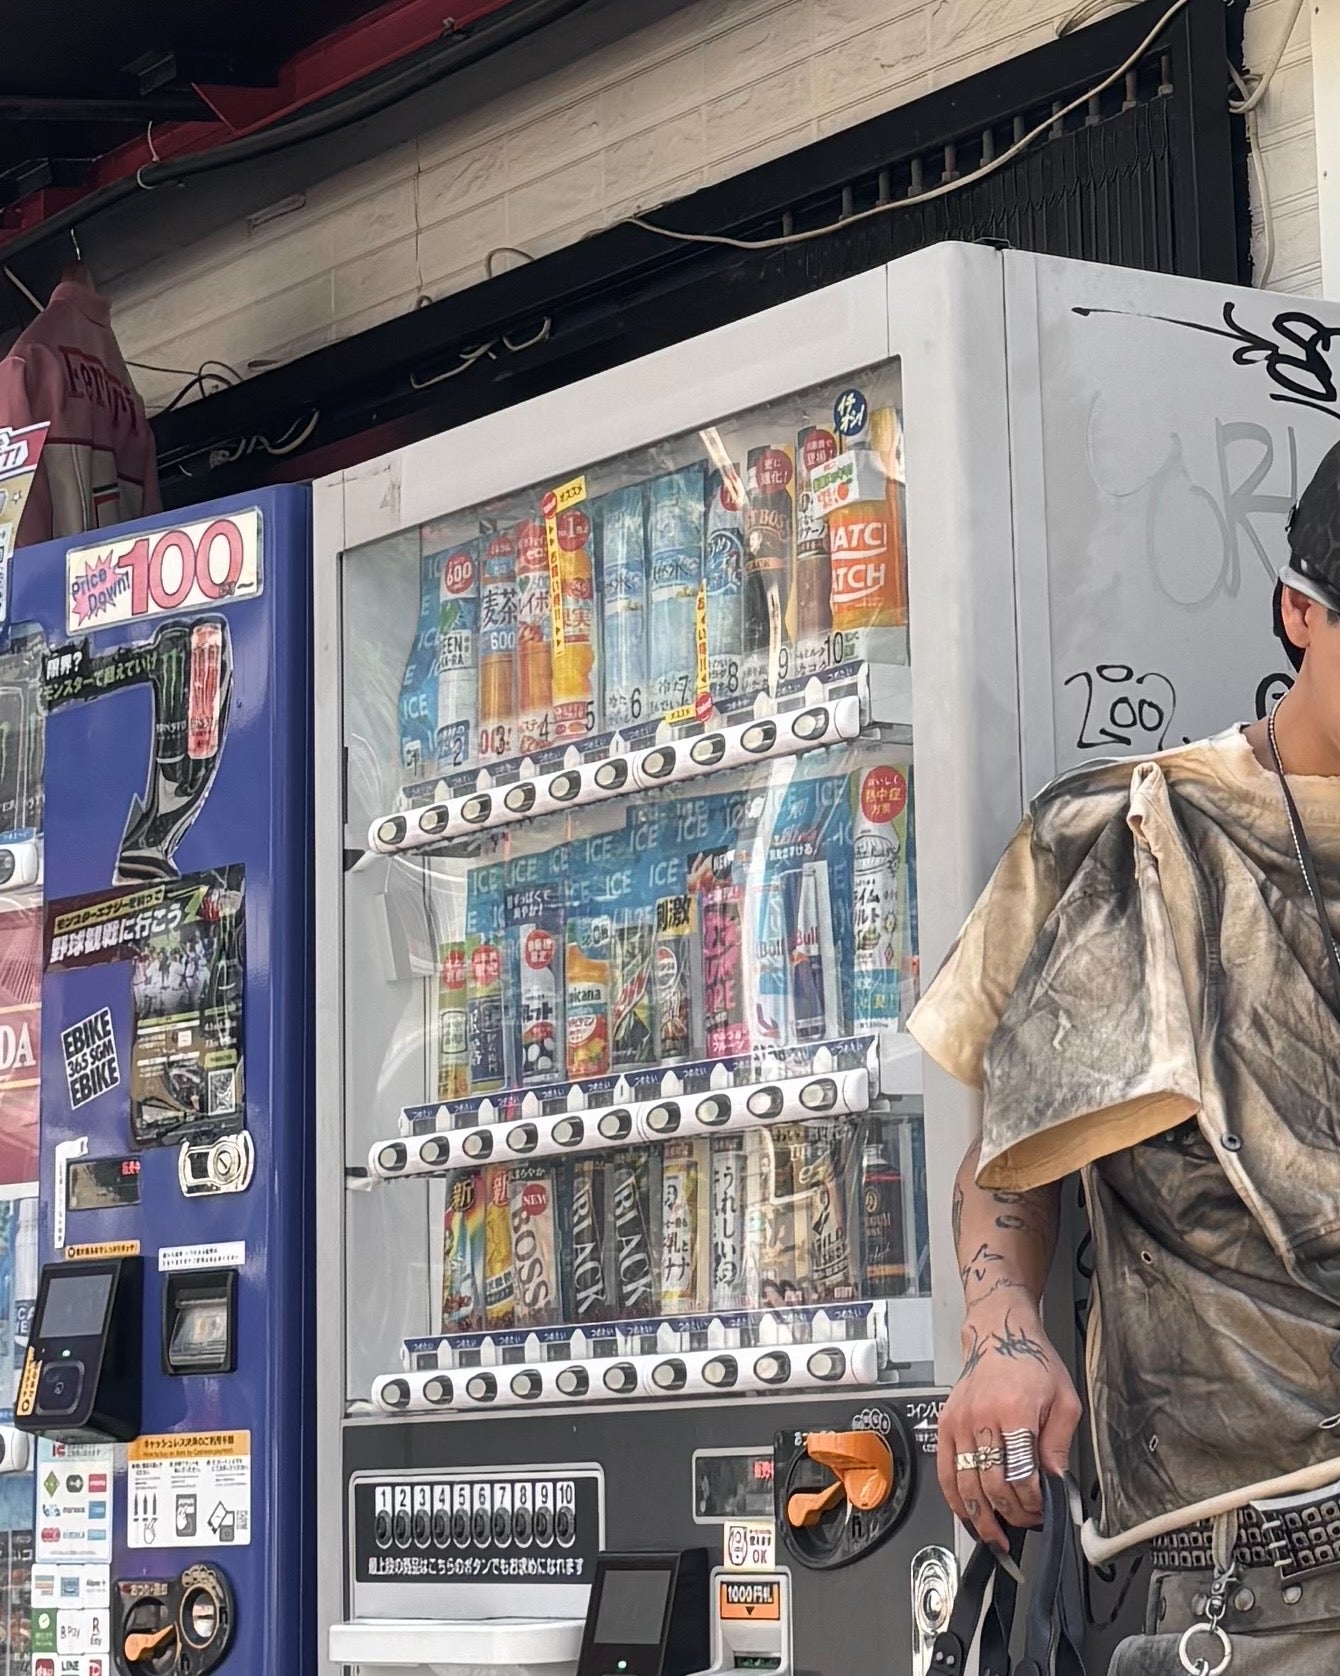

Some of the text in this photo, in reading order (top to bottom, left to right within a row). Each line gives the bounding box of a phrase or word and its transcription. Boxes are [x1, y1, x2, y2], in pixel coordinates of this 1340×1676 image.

[832, 522, 887, 548] ATC
[118, 519, 244, 616] 100
[447, 562, 472, 586] 600
[72, 566, 130, 616] Price Down!
[483, 589, 517, 626] 麦茶
[491, 631, 515, 649] 600
[825, 632, 843, 666] 10
[728, 662, 739, 692] 8
[779, 648, 788, 679] 9
[631, 688, 641, 718] 6
[679, 675, 689, 706] 7
[403, 693, 429, 720] ICE
[586, 701, 595, 731] 5
[496, 726, 505, 755] 3
[540, 714, 550, 741] 4
[630, 825, 657, 851] ICE
[677, 816, 707, 843] ICE
[586, 836, 612, 862] ICE
[474, 870, 497, 894] ICE
[606, 869, 631, 896] ICE
[650, 860, 678, 888] ICE
[64, 1010, 111, 1059] EBIKE
[67, 1055, 89, 1078] 365
[70, 1056, 120, 1107] EBIKE
[452, 1180, 475, 1212] 新
[492, 1171, 509, 1206] 新
[522, 1194, 547, 1206] NEW
[573, 1183, 606, 1314] BLACK
[614, 1176, 653, 1307] BLACK
[512, 1209, 549, 1308] BOSS
[381, 1484, 573, 1507] 1 2 3 4 5 6 7 8 9 10
[368, 1557, 584, 1576] 最上段の商品はこちらのボタンでもお求めになれます
[753, 1549, 768, 1564] OK
